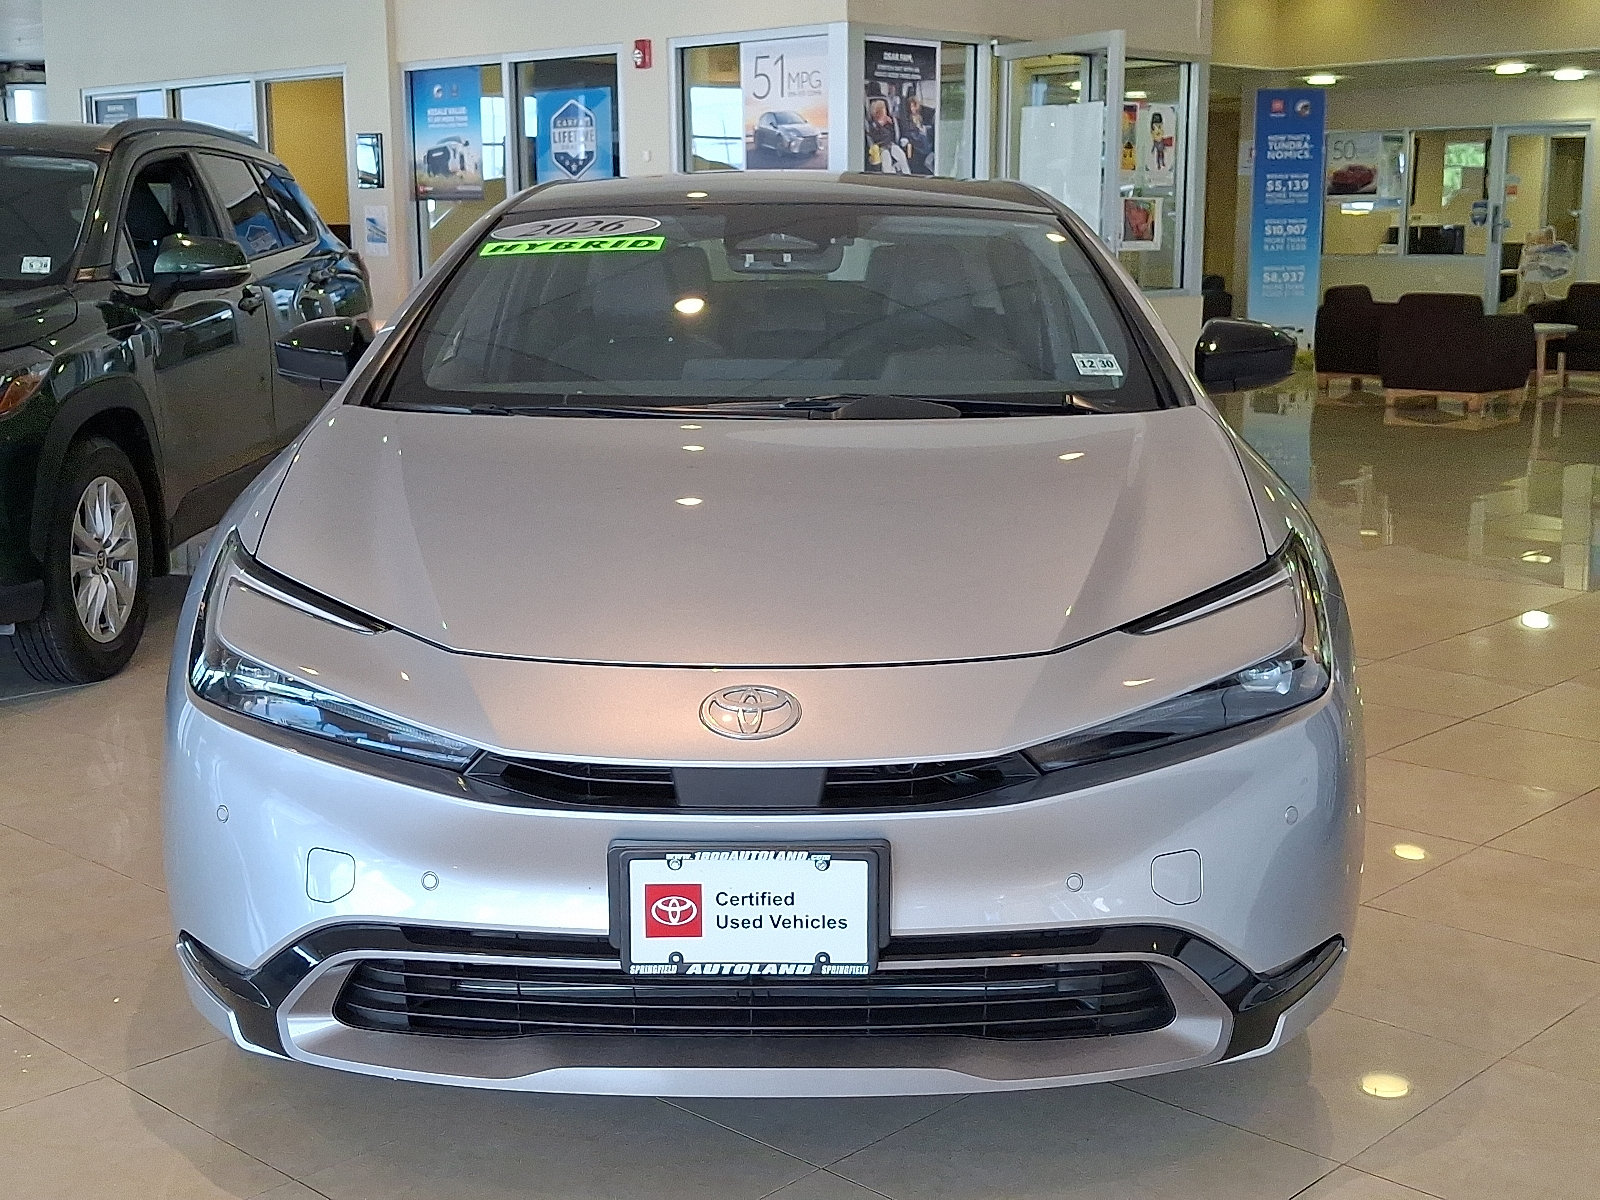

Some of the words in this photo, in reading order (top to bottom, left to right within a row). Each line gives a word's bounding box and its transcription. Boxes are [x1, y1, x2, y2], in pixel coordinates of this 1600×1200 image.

[753, 54, 786, 100] 51
[788, 71, 822, 90] MPG
[1265, 180, 1309, 192] $5,139
[520, 218, 624, 236] 2026
[1264, 224, 1307, 236] $10,907
[488, 239, 658, 253] HYBRID
[1079, 359, 1096, 368] 12
[1098, 359, 1114, 368] 30
[715, 891, 796, 907] Certified
[715, 915, 763, 930] Used
[769, 914, 848, 930] Vehicles
[629, 964, 678, 975] SPRINGFIELD
[685, 963, 814, 975] AUTOLAND
[821, 964, 870, 975] SPRINGFIELD
